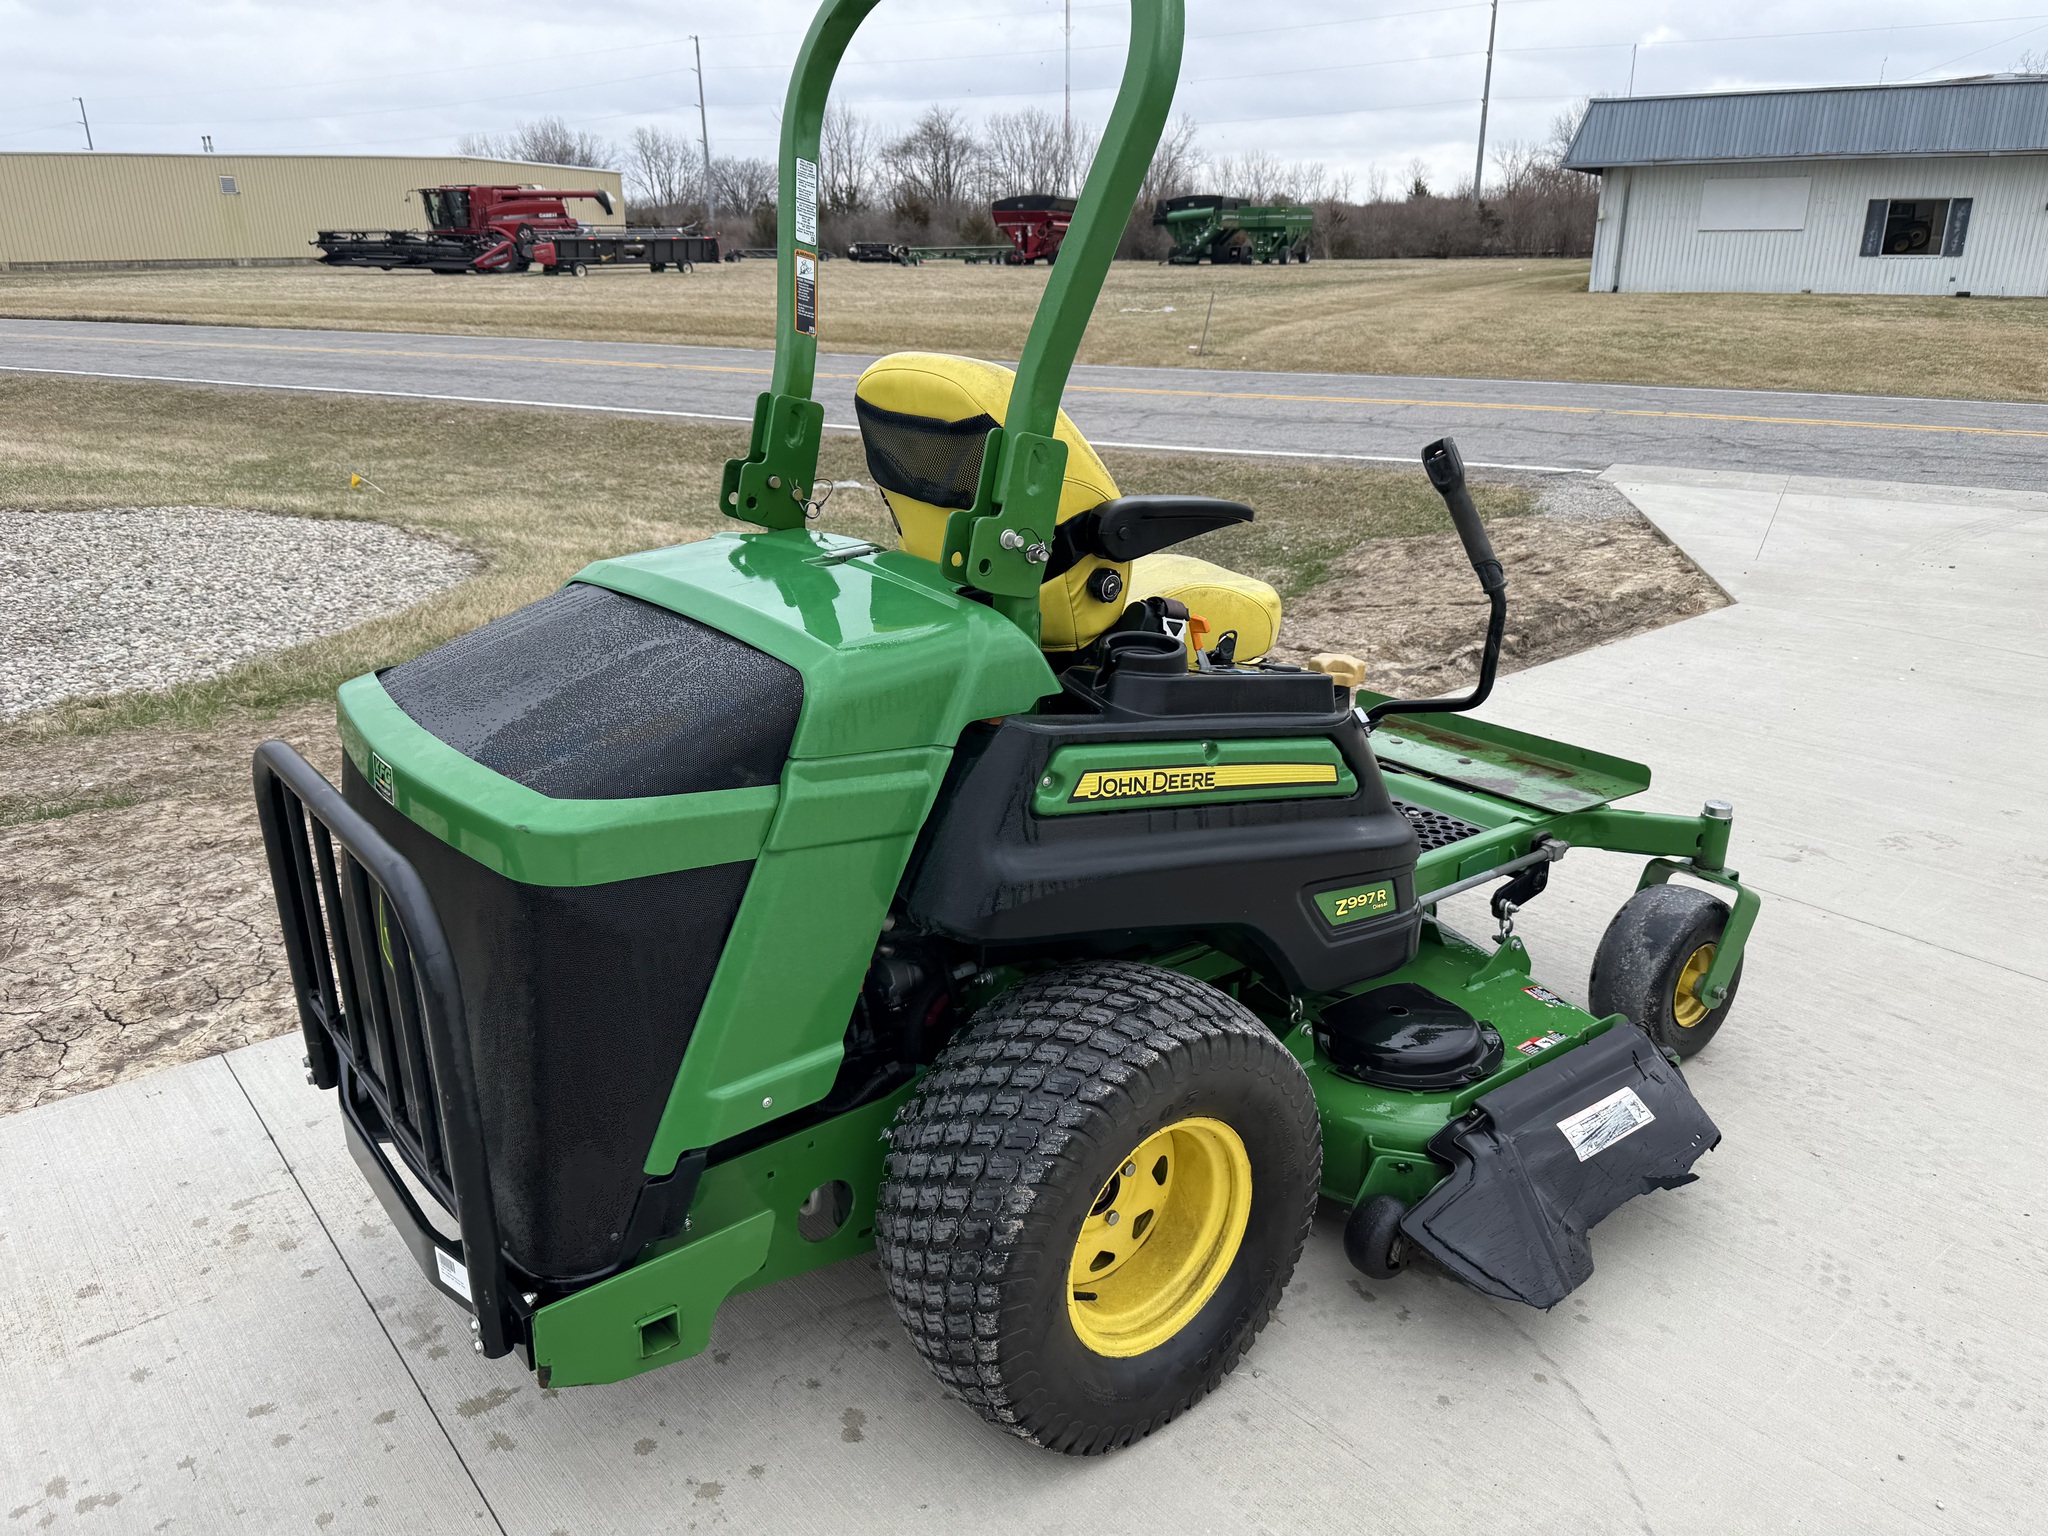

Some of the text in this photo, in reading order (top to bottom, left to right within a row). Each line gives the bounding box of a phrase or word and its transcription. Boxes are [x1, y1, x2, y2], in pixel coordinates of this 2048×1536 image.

[1089, 771, 1216, 796] JOHN DEERE
[1372, 901, 1388, 910] Diesel
